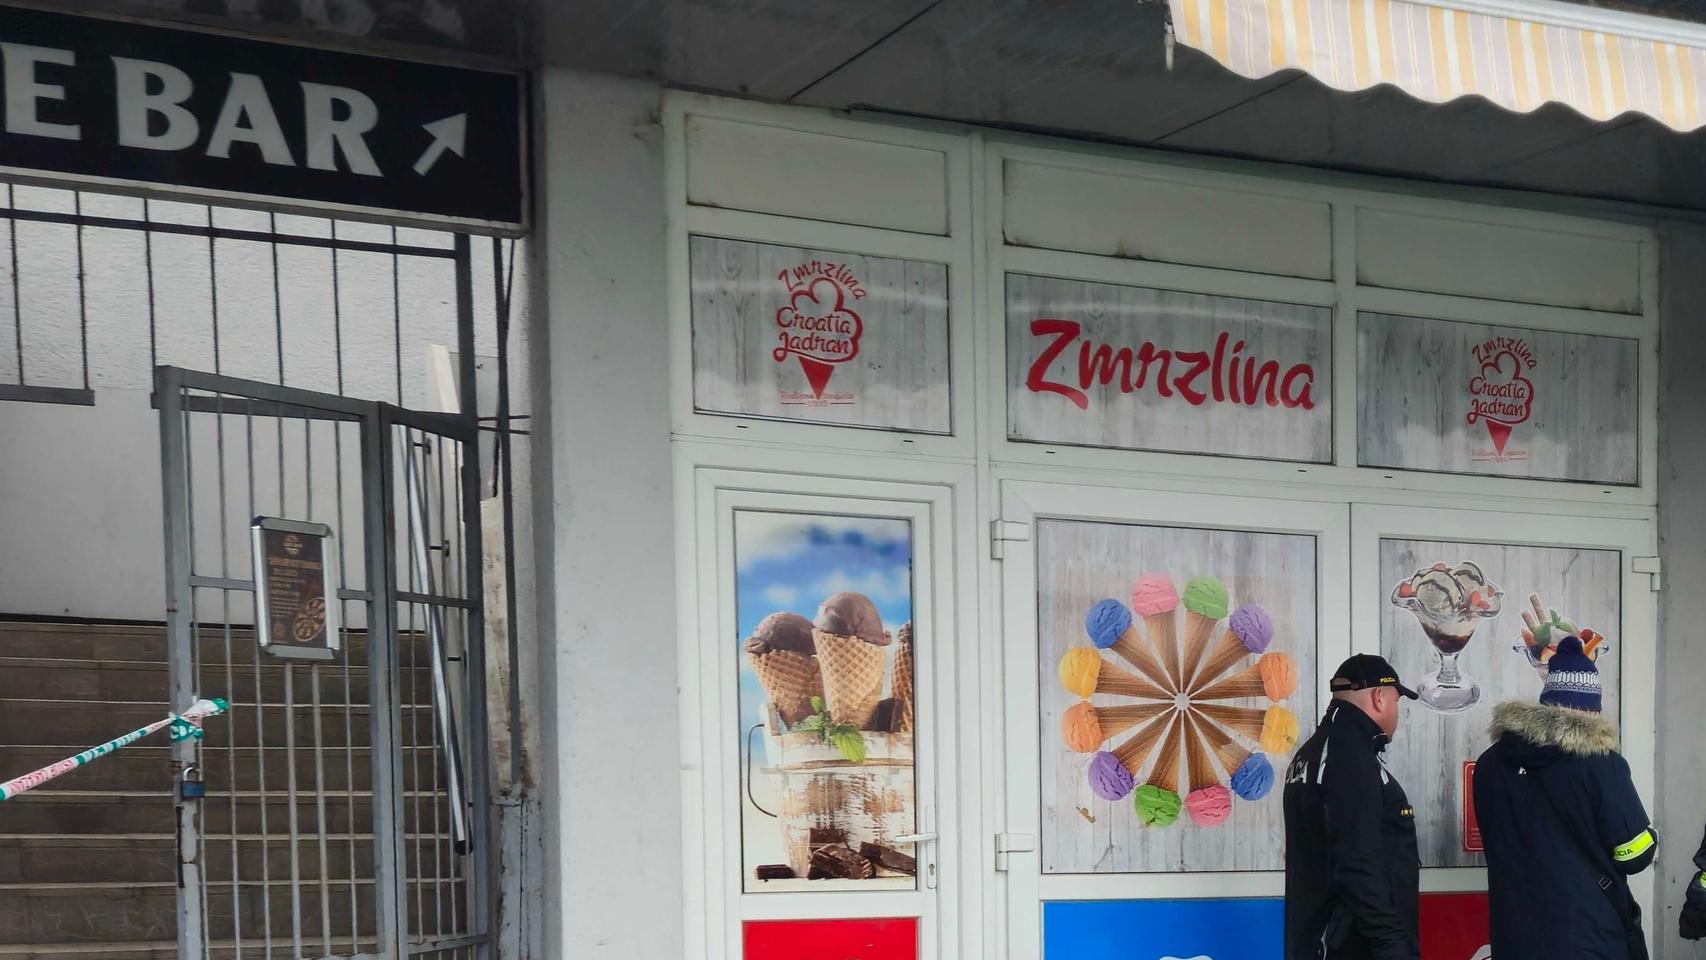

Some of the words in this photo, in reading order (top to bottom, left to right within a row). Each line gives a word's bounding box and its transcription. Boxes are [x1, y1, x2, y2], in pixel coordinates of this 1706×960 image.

[111, 56, 384, 178] BAR
[778, 260, 867, 300] Zmrzlina
[776, 306, 851, 334] Croatia
[773, 331, 850, 362] Jadran
[1472, 336, 1538, 370] Zmrzlina
[1025, 319, 1315, 410] Zmrzlina
[1470, 376, 1526, 399] Croatia
[1467, 399, 1524, 424] Jadran
